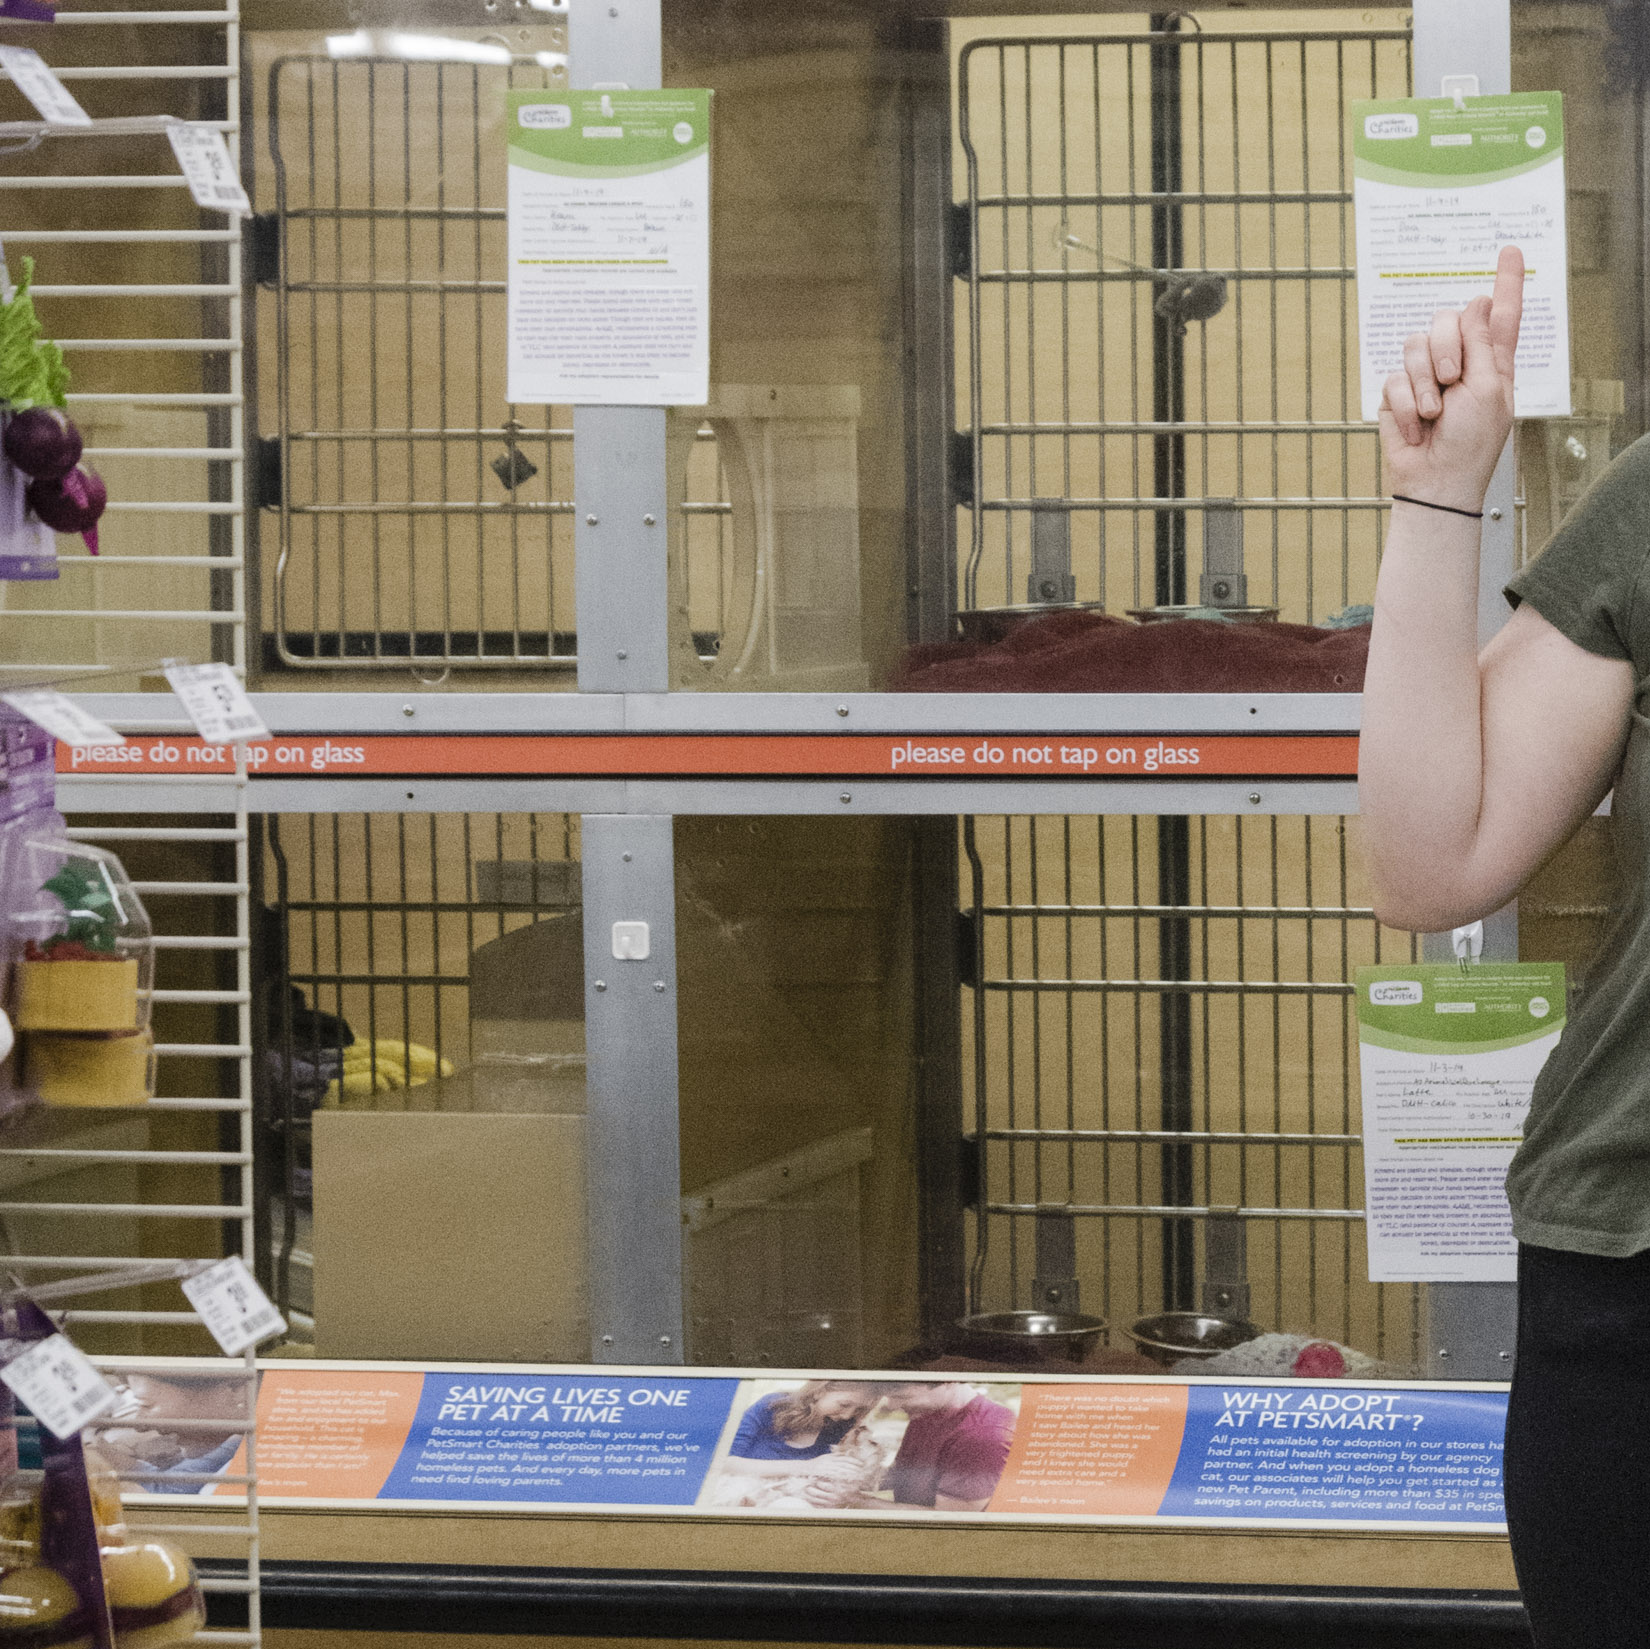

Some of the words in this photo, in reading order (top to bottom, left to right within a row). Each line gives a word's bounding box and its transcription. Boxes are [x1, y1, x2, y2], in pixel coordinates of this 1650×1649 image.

[71, 743, 143, 768] please
[149, 740, 181, 764] do
[186, 744, 225, 764] not
[275, 744, 305, 764] on
[310, 740, 366, 770] glass
[891, 741, 966, 769] please
[972, 741, 1005, 764] do
[1012, 746, 1053, 764] not
[1059, 746, 1099, 771] tap
[1105, 747, 1137, 765] on
[1143, 742, 1200, 771] glass
[1374, 988, 1418, 1002] Charities
[446, 1385, 546, 1404] SAVING
[551, 1388, 622, 1405] LIVES
[627, 1389, 691, 1407] ONE
[1222, 1391, 1294, 1411] WHY
[1298, 1393, 1401, 1412] ADOPT
[437, 1404, 488, 1422] PET
[489, 1404, 529, 1421] AT
[529, 1405, 550, 1422] A
[560, 1405, 625, 1424] TIME
[1214, 1410, 1253, 1428] AT
[430, 1426, 483, 1437] Because
[484, 1427, 501, 1437] of
[500, 1429, 540, 1440] caring
[541, 1429, 587, 1440] people
[588, 1429, 611, 1439] like
[612, 1431, 637, 1441] you
[638, 1430, 665, 1440] and
[665, 1432, 689, 1440] our
[1209, 1434, 1229, 1444] All
[1229, 1436, 1260, 1446] pets
[1262, 1436, 1319, 1446] available
[1321, 1436, 1341, 1447] for
[1342, 1437, 1402, 1449] adoption
[1405, 1439, 1418, 1448] in
[1420, 1441, 1443, 1449] our
[1445, 1441, 1486, 1450] stores
[424, 1438, 484, 1452] PetSmart
[545, 1441, 604, 1454] adoption
[603, 1443, 661, 1455] partners,
[662, 1443, 701, 1456] we've
[1206, 1446, 1233, 1457] had
[1234, 1449, 1252, 1457] an
[1254, 1448, 1290, 1458] initial
[1291, 1448, 1332, 1459] health
[1334, 1451, 1398, 1463] screening
[1400, 1450, 1418, 1463] by
[1419, 1453, 1443, 1461] our
[1445, 1454, 1494, 1465] agency
[1203, 1460, 1254, 1470] partner.
[1257, 1460, 1287, 1470] And
[1288, 1461, 1324, 1471] when
[1326, 1464, 1352, 1476] you
[1353, 1462, 1394, 1474] adopt
[1408, 1463, 1470, 1474] homeless
[1472, 1465, 1500, 1477] dog
